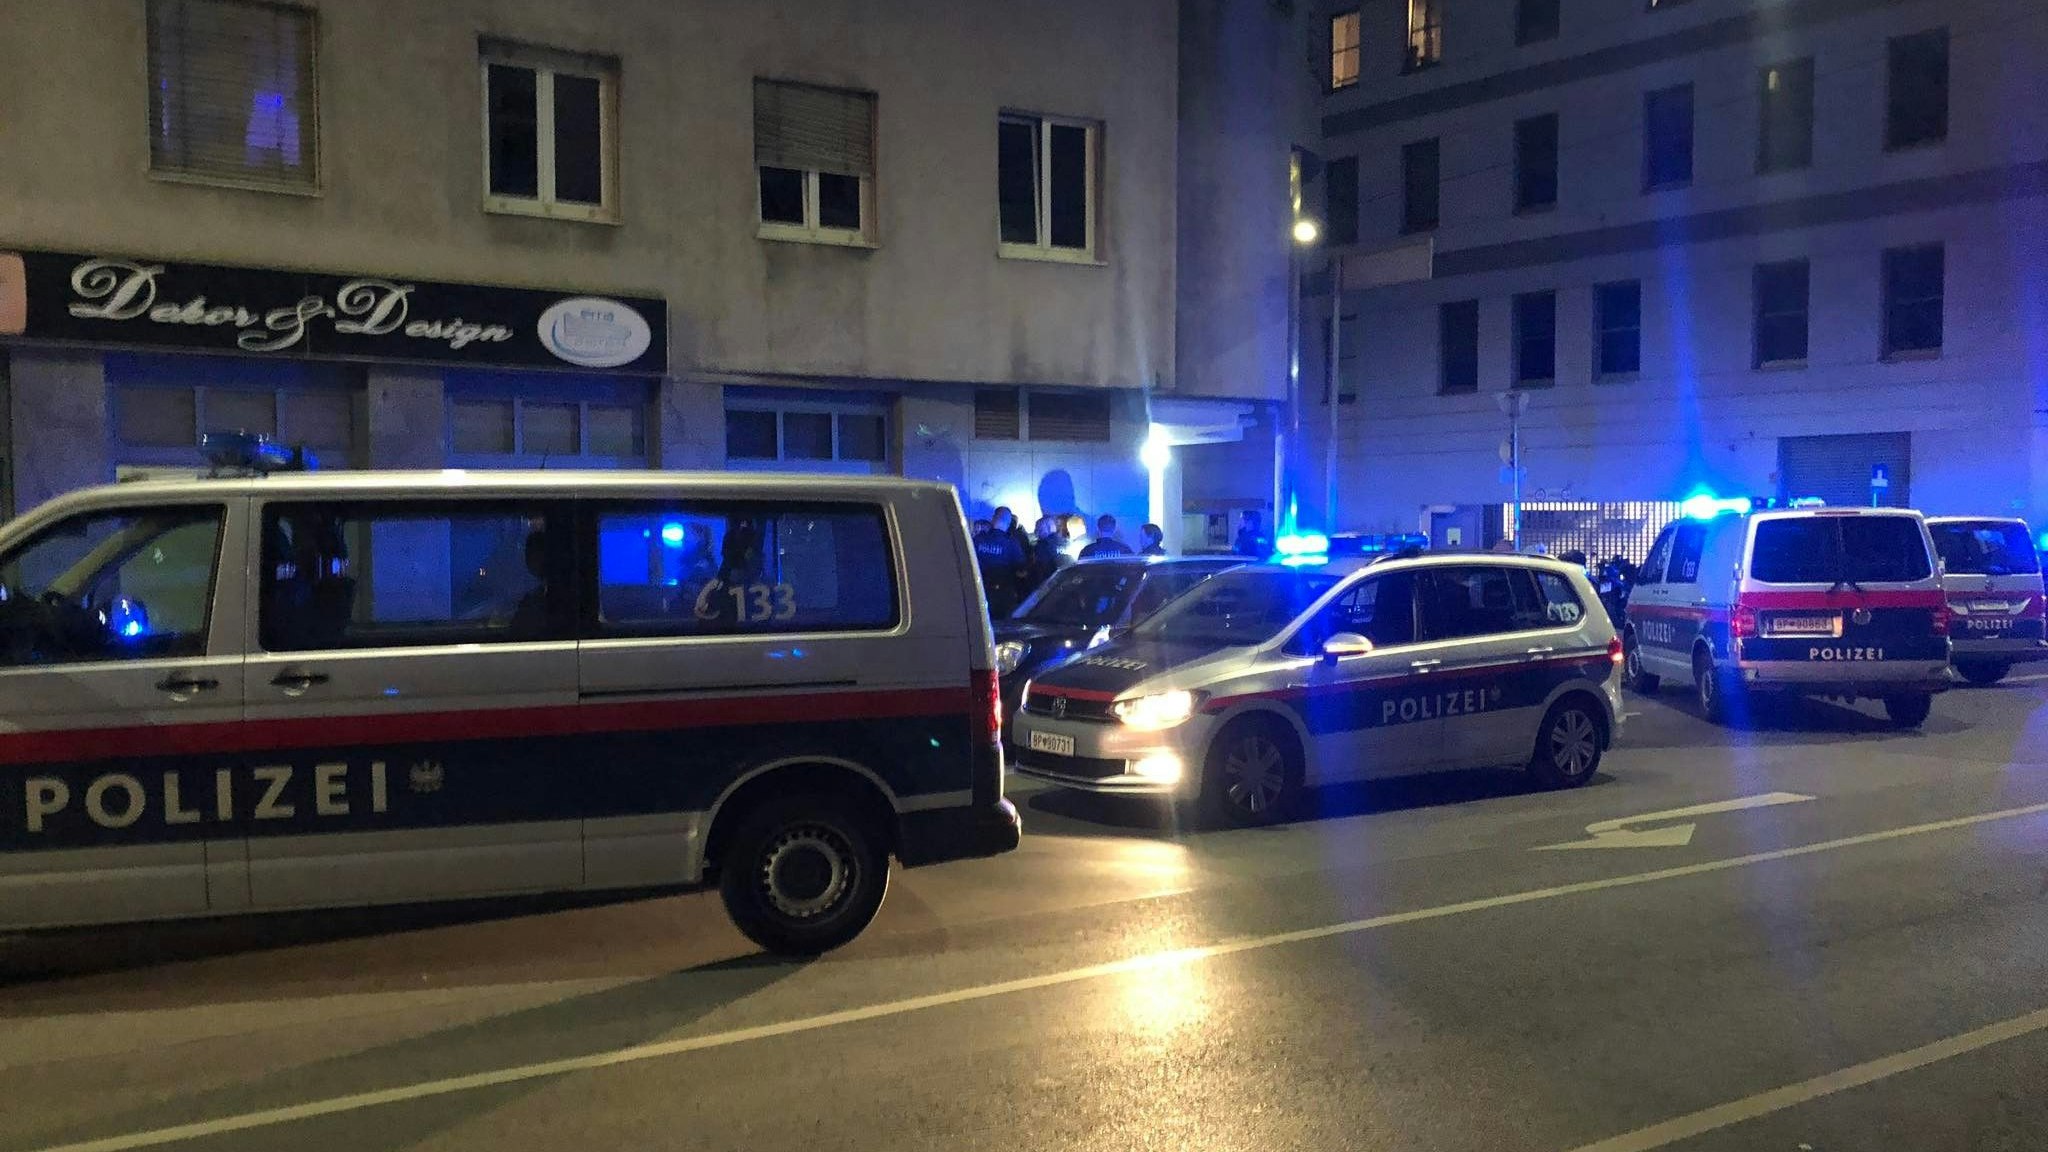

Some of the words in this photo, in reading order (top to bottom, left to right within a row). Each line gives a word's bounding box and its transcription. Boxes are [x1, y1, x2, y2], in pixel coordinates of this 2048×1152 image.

[237, 295, 336, 351] &
[335, 278, 514, 350] Design
[728, 583, 797, 621] 133
[1642, 620, 1672, 643] POLIZEI
[1967, 619, 2013, 630] POLIZEI
[1809, 647, 1883, 660] POLIZEI
[1382, 689, 1486, 723] POLIZEI
[25, 761, 388, 832] POLIZEI
